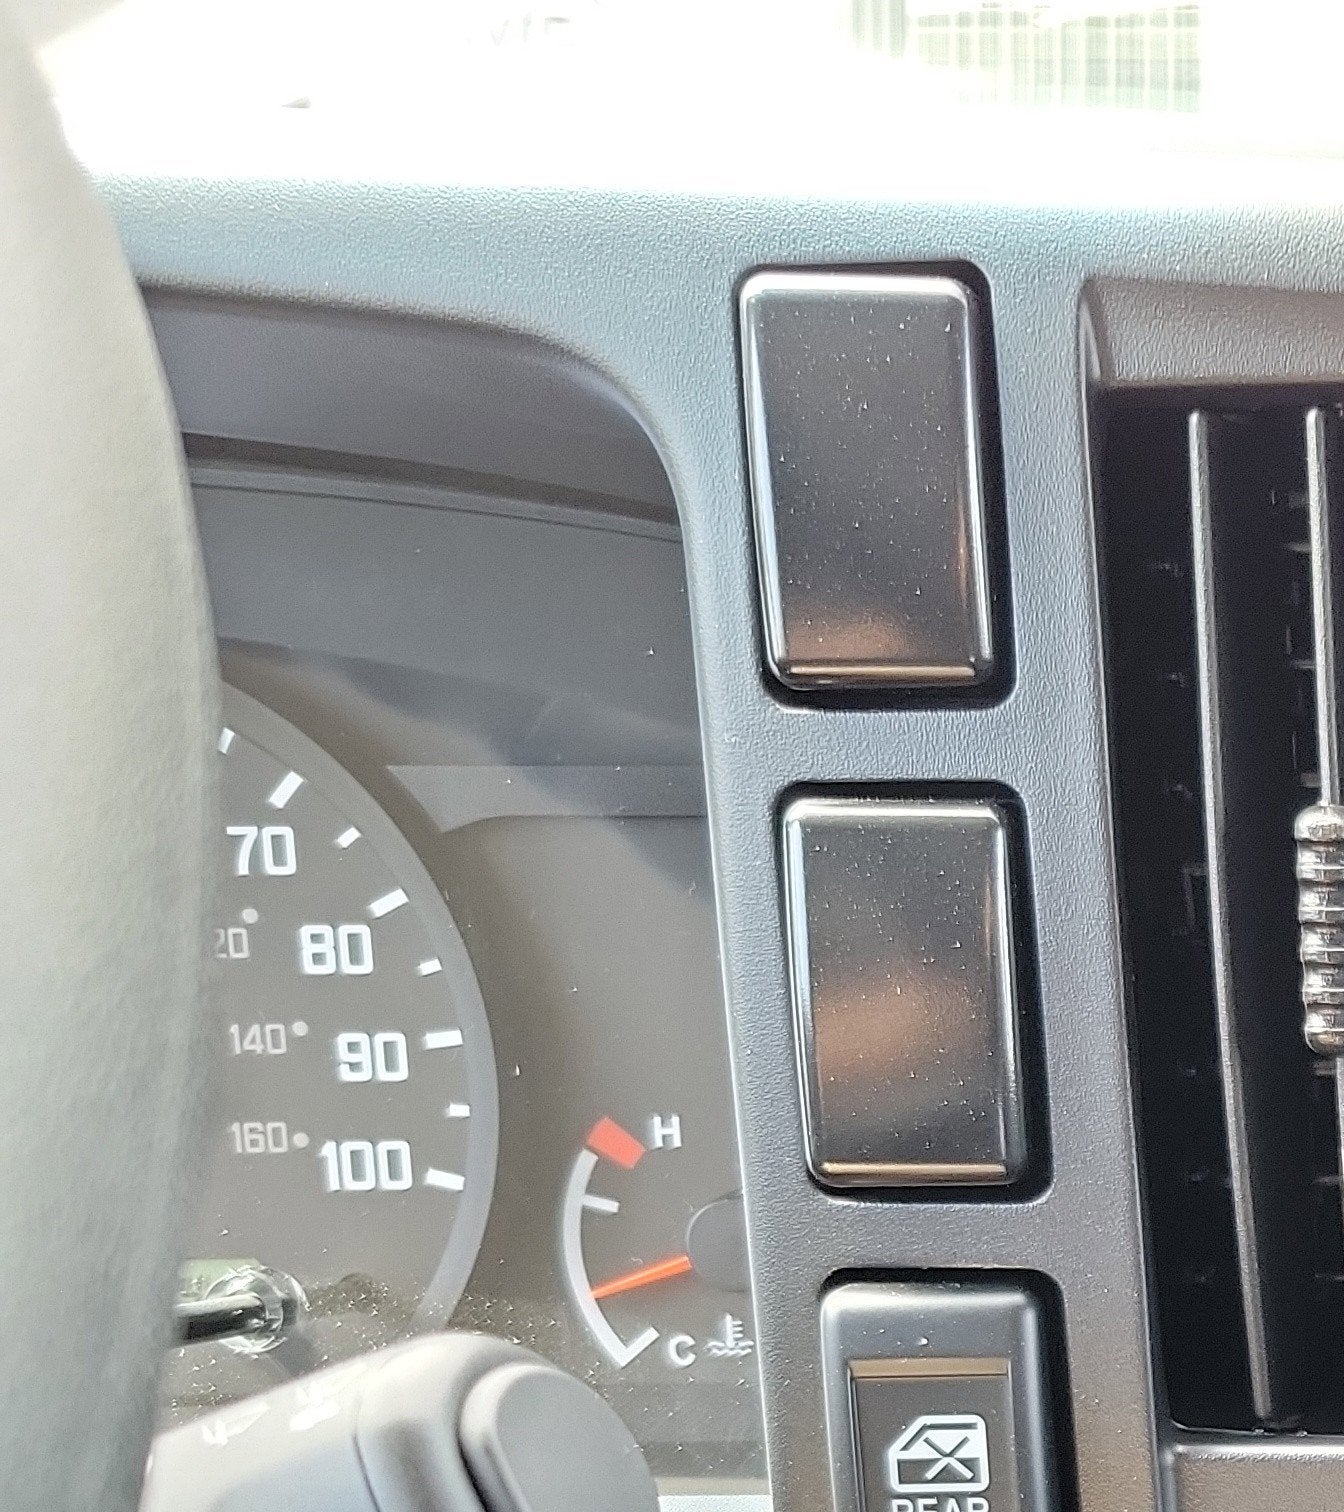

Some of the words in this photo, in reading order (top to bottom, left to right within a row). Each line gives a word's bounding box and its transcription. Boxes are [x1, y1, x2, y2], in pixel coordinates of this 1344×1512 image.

[226, 825, 297, 876] 70
[214, 926, 250, 959] 20
[298, 924, 374, 975] 80
[229, 1023, 287, 1055] 140
[335, 1031, 409, 1083] 90
[231, 1121, 287, 1154] 160
[651, 1113, 682, 1149] H
[318, 1140, 413, 1192] 100
[668, 1335, 698, 1368] C
